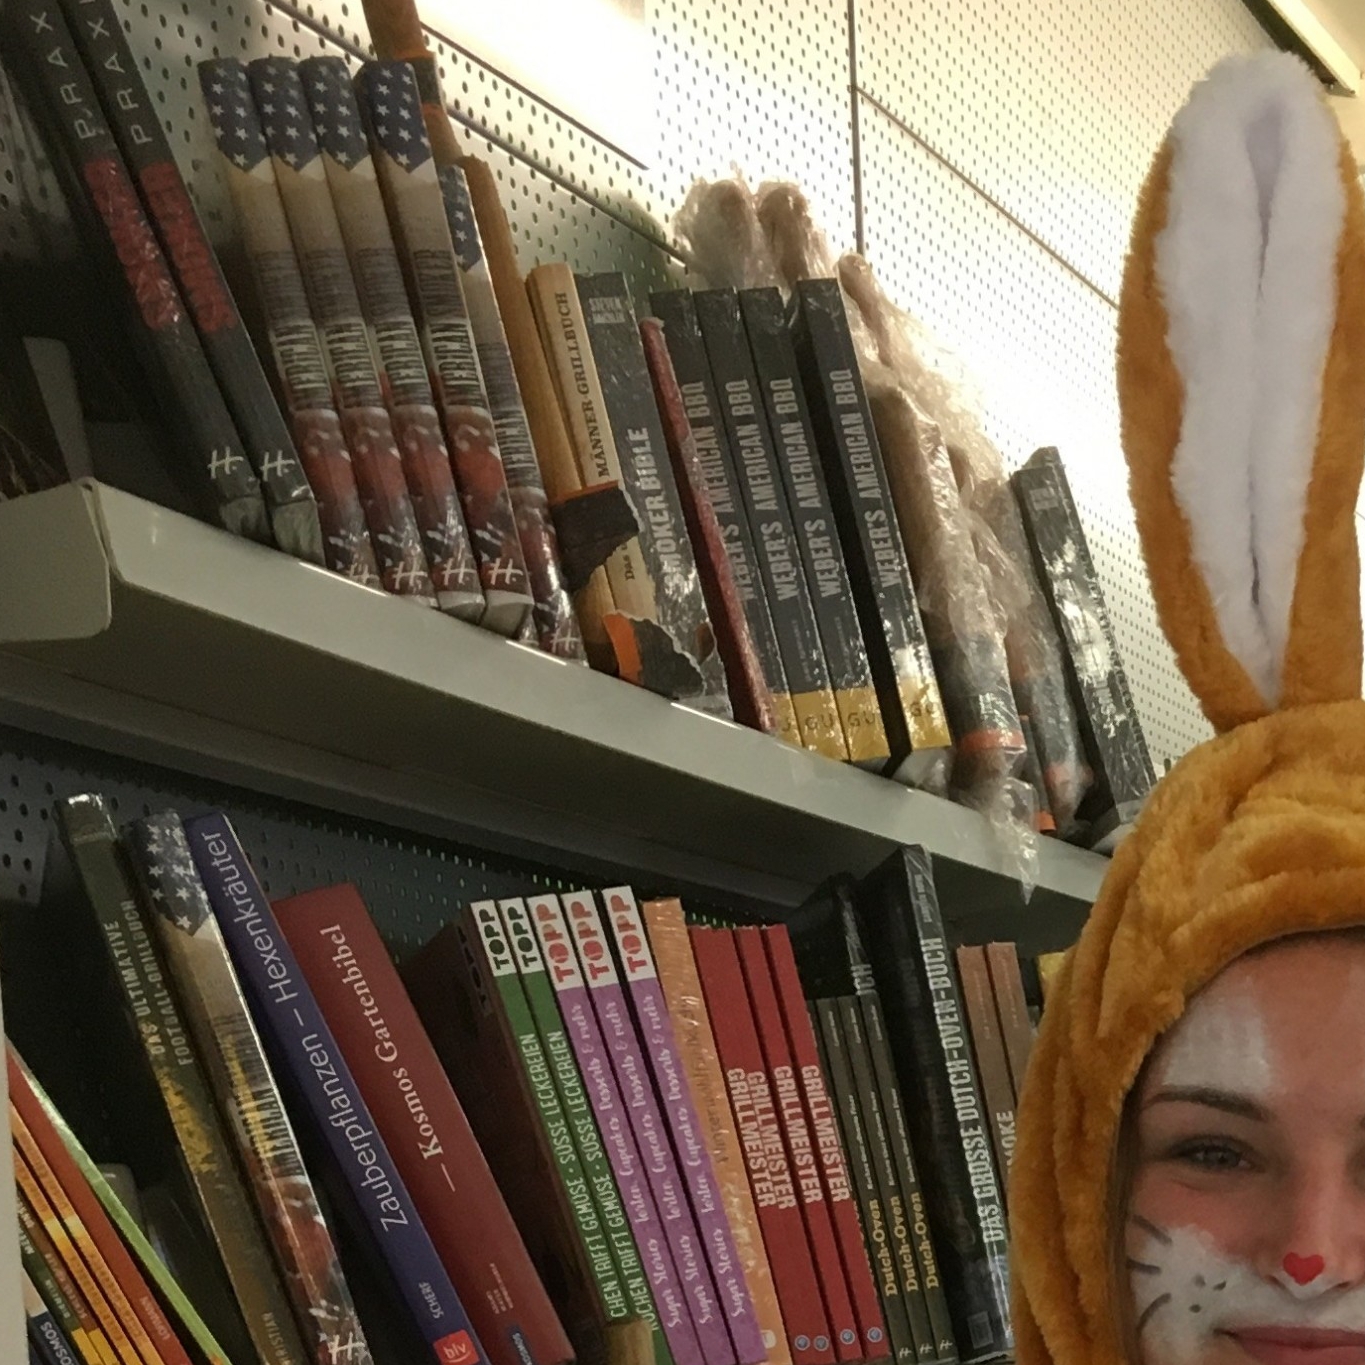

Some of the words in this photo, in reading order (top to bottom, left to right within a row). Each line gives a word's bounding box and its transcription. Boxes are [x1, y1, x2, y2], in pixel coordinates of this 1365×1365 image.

[428, 320, 487, 407] AMERICAN
[681, 380, 710, 418] BBQ
[725, 378, 755, 417] BBQ
[769, 377, 799, 414] BBQ
[829, 369, 858, 405] BBQ
[626, 427, 662, 490] BIBLE
[693, 426, 734, 513] AMERICAN
[736, 424, 778, 511] AMERICAN
[780, 421, 822, 509] AMERICAN
[839, 412, 882, 499] AMERICAN
[644, 493, 687, 596] SMOKER
[760, 520, 799, 601] WEBER'S
[804, 518, 842, 598] WEBER'S
[864, 509, 903, 588] WEBER'S
[201, 831, 298, 1005] Hexenkräuter
[479, 908, 509, 971] TOPP
[508, 906, 538, 968] TOPP
[535, 903, 575, 983] TOPP
[570, 901, 610, 981] TOPP
[610, 895, 648, 974] TOPP
[104, 920, 150, 1018] ULTIMATIVE
[319, 925, 397, 1064] Gartenbibel
[140, 1022, 168, 1056] DAS
[920, 938, 979, 1121] DUTCH-OVEN-BUCH
[519, 1033, 561, 1117] LECKEREIEN
[547, 1030, 587, 1113] LECKEREIEN
[588, 1058, 613, 1111] Desserts
[621, 1054, 647, 1108] Desserts
[657, 1049, 682, 1102] Desserts
[301, 1034, 409, 1233] Zauberpflanzen
[393, 1068, 445, 1163] Kosmos
[548, 1118, 575, 1164] SÜSSE
[575, 1116, 603, 1161] SÜSSE
[726, 1068, 777, 1208] GRILLMEISTER
[746, 1071, 796, 1210] GRILLMEISTER
[773, 1065, 824, 1204] GRILLMEISTER
[801, 1064, 851, 1203] GRILLMEISTER
[592, 1174, 625, 1228] GEMÜSE
[960, 1126, 1000, 1200] GROSSE
[566, 1176, 599, 1231] GEMÜSE
[910, 1192, 939, 1289] Dutch-Oven
[977, 1202, 1005, 1243] DAS
[585, 1234, 613, 1279] TRIFFT
[611, 1231, 638, 1276] TRIFFT
[648, 1239, 668, 1285] Stories
[679, 1235, 699, 1281] Stories
[713, 1228, 733, 1275] Stories
[869, 1199, 898, 1296] Dutch-Oven
[890, 1196, 918, 1291] Dutch-Oven
[418, 1281, 444, 1320] SCHERF
[661, 1289, 683, 1328] Sugar
[694, 1285, 713, 1325] Sugar
[726, 1278, 746, 1318] Sugar
[443, 1342, 467, 1359] blv
